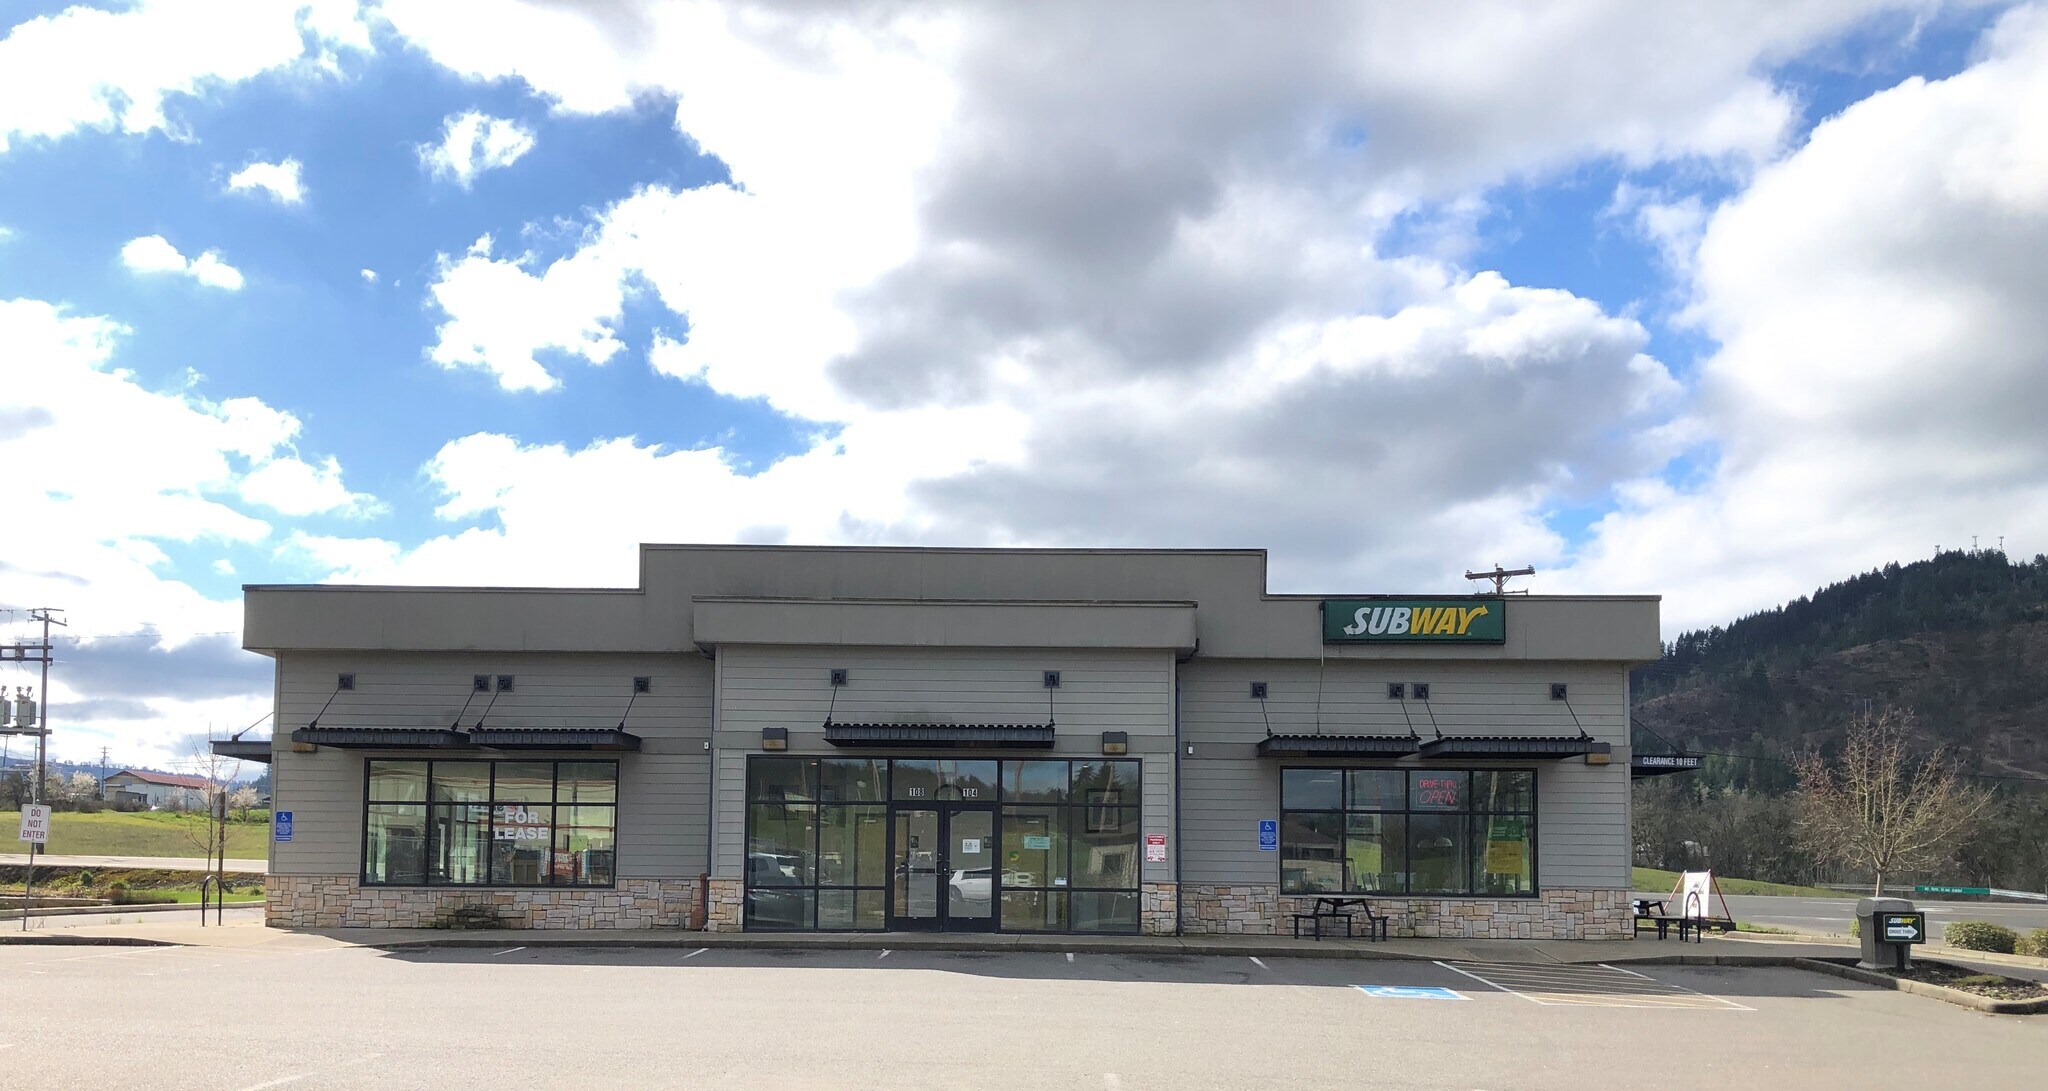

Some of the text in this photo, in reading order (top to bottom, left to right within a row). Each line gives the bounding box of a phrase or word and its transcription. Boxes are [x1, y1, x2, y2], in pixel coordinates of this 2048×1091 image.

[1343, 605, 1488, 635] SUBWAY
[1643, 757, 1698, 766] CLEARANCE 10 FEET
[910, 788, 924, 796] 108
[963, 788, 977, 797] 104
[1420, 790, 1457, 804] OPEN
[31, 809, 41, 817] DO
[505, 811, 539, 823] FOR
[28, 820, 42, 828] NOT
[22, 830, 45, 839] ENTER
[495, 827, 549, 839] LEASE
